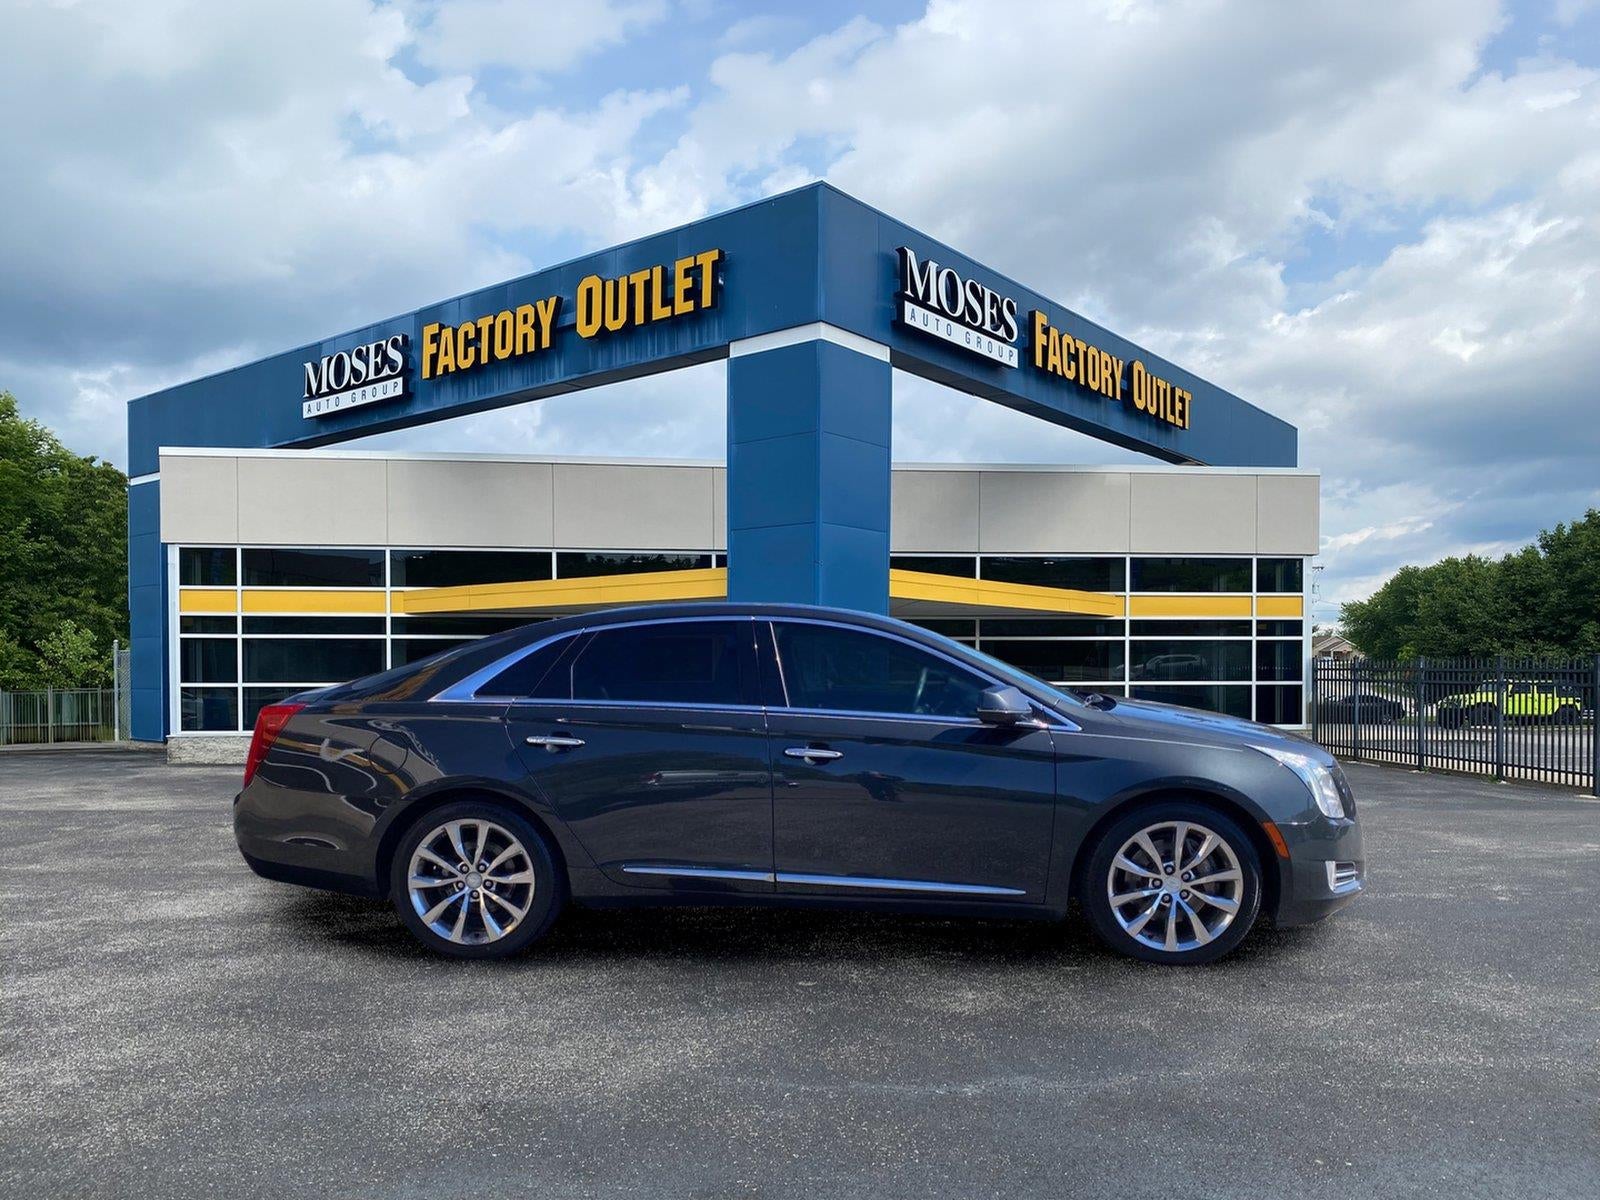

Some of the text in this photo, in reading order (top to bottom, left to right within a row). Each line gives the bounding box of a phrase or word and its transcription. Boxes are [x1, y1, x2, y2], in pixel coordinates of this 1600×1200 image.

[422, 249, 720, 379] FACTORY OUTLET
[904, 247, 1018, 343] MOSES
[910, 308, 1014, 362] AUTO GROUP
[303, 334, 404, 398] MOSES
[307, 381, 399, 414] AUTO GROUP
[1034, 310, 1192, 430] FACTORY OUTLET
